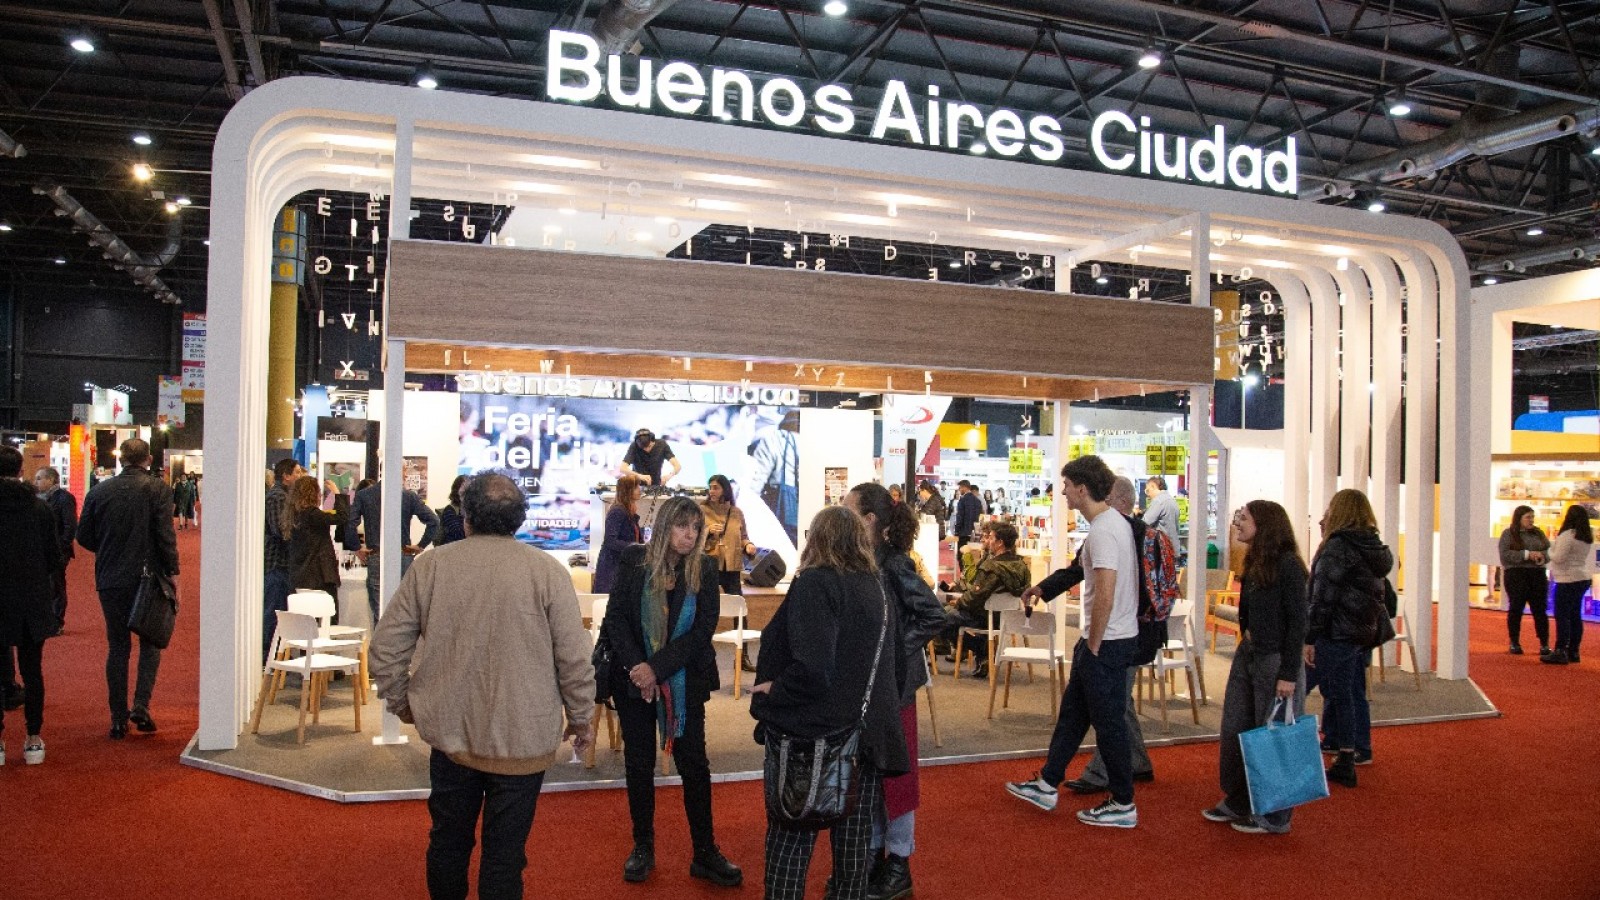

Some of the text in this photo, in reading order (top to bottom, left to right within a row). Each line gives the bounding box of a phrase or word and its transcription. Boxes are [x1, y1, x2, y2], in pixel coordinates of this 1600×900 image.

[547, 29, 1298, 194] Buenos Aires Ciudad
[964, 251, 977, 266] R
[485, 406, 579, 436] Feria
[484, 437, 622, 471] del Libr
